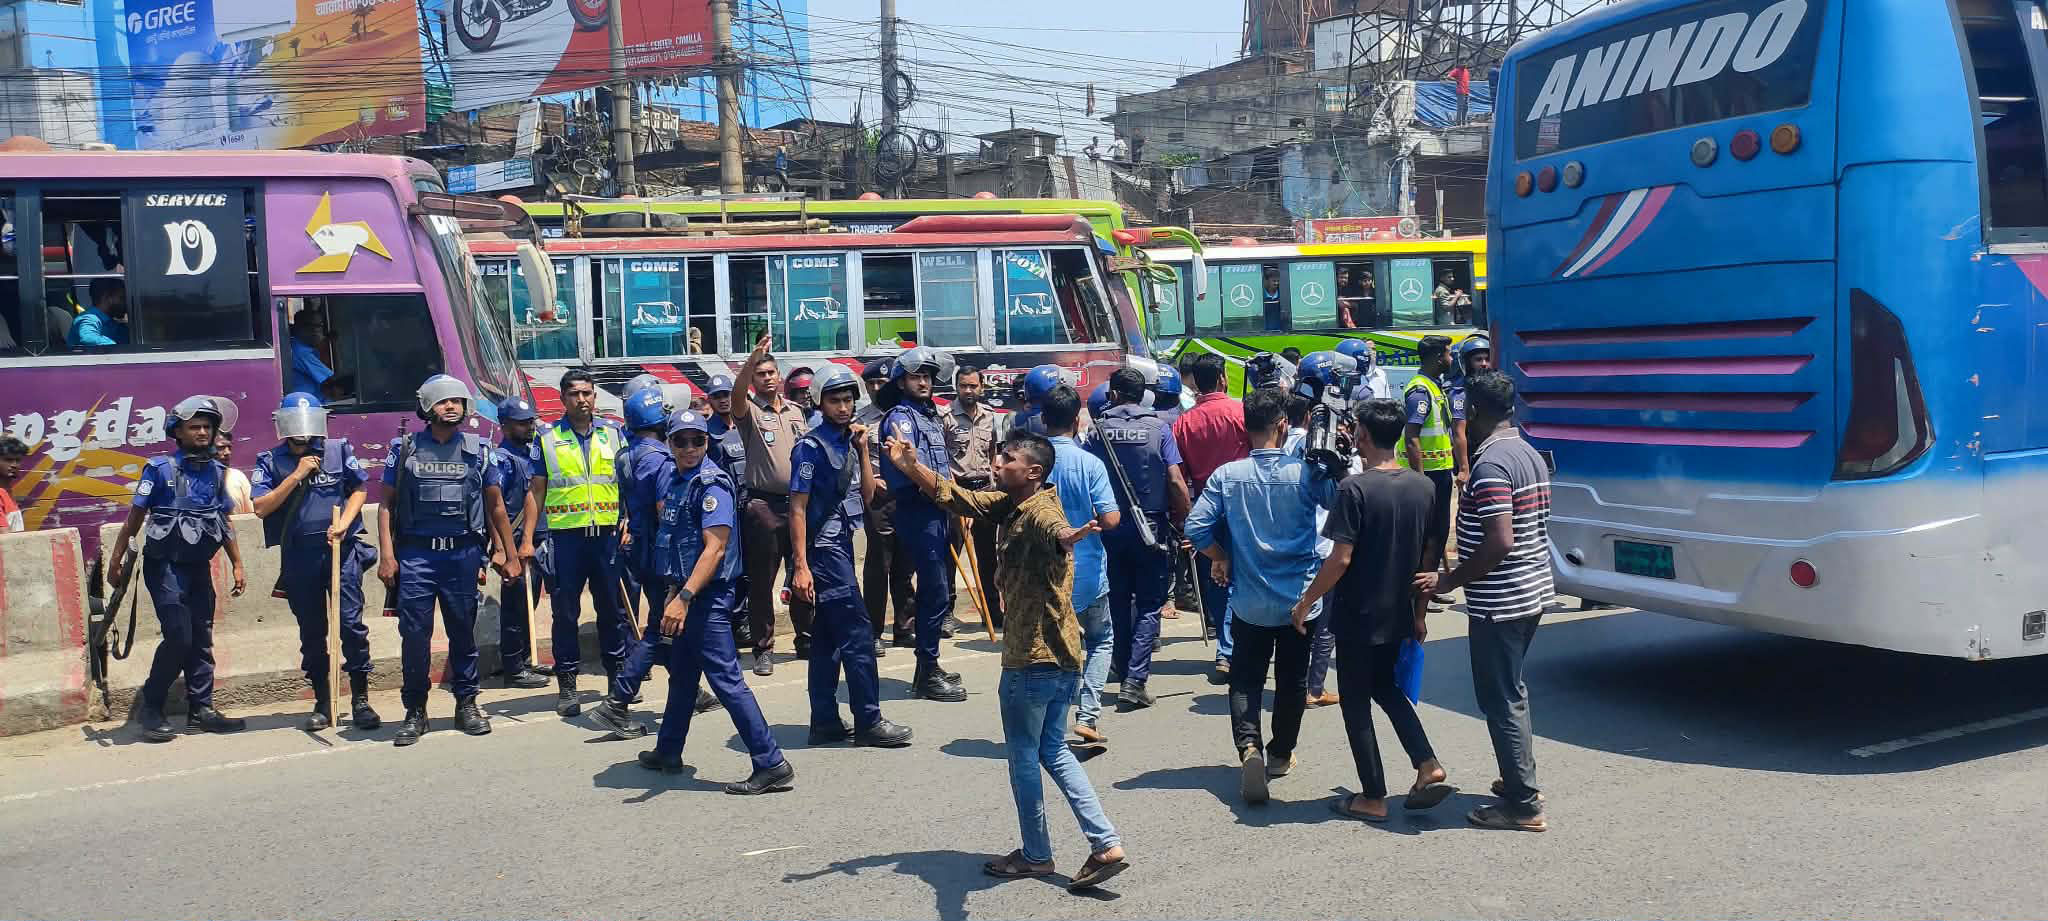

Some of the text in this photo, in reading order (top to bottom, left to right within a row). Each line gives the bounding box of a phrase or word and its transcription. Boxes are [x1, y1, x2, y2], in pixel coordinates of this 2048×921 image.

[145, 1, 196, 29] GREE
[1527, 0, 1808, 122] ANINDO
[145, 193, 227, 207] SERVICE
[850, 224, 893, 234] TRANSPORT
[792, 257, 839, 268] COME
[920, 255, 966, 266] WELL
[631, 261, 680, 272] COME
[415, 463, 465, 473] POLICE
